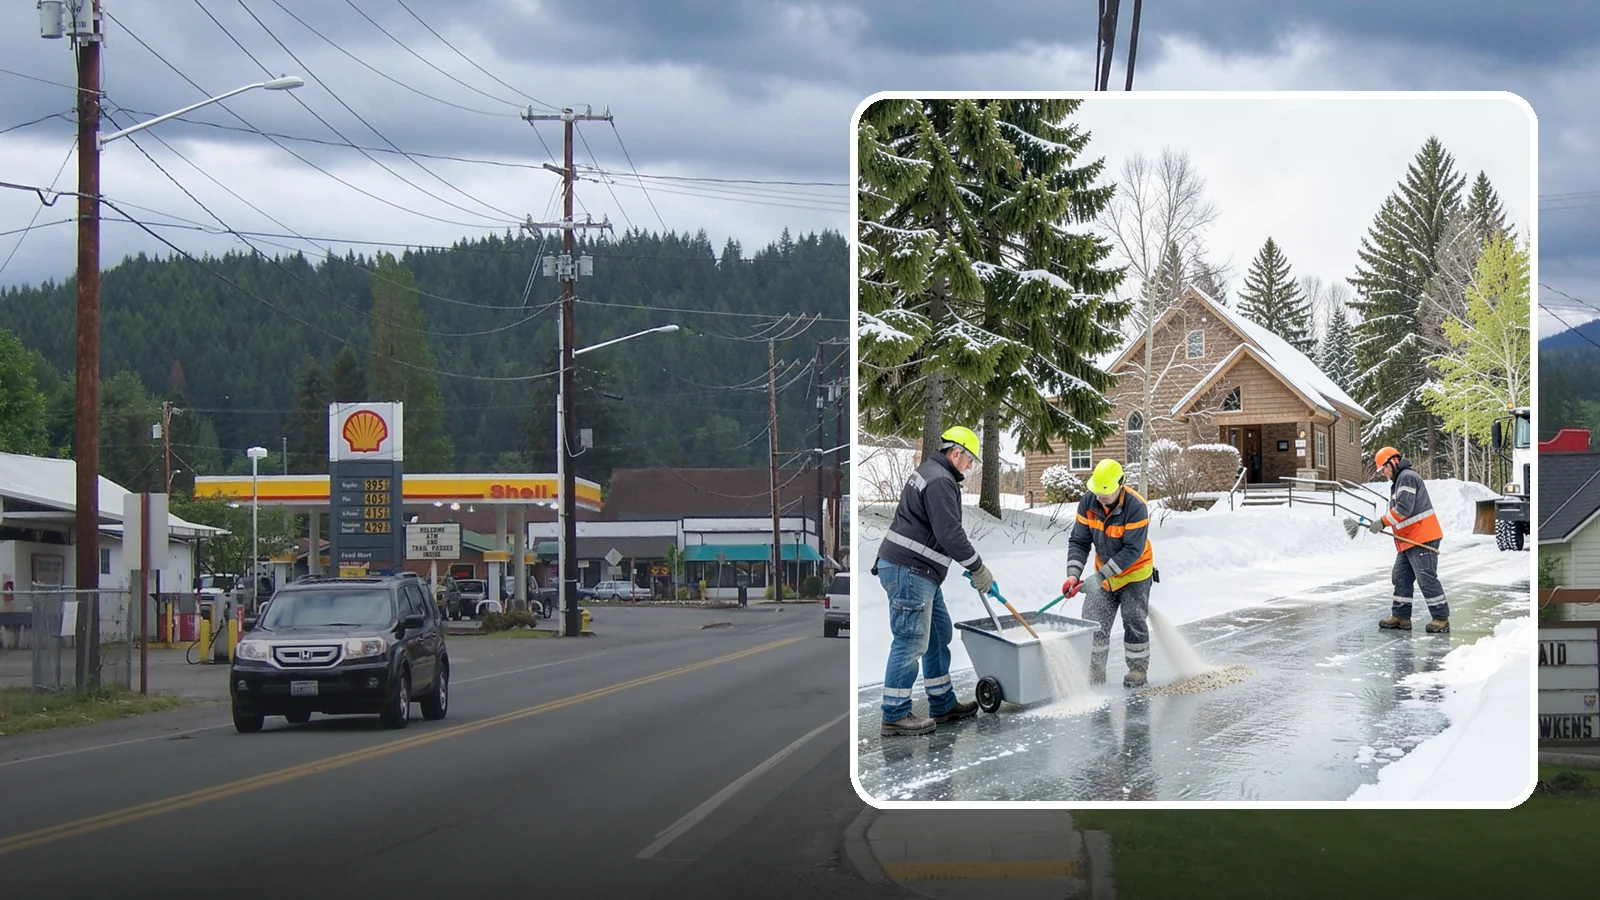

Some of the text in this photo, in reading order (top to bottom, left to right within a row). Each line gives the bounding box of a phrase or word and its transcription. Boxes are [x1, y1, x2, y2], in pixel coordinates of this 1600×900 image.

[366, 480, 383, 490] 395
[490, 484, 547, 499] Shell
[366, 494, 383, 504] 405
[366, 508, 383, 518] 415
[366, 522, 383, 532] 429
[1538, 643, 1566, 665] AID
